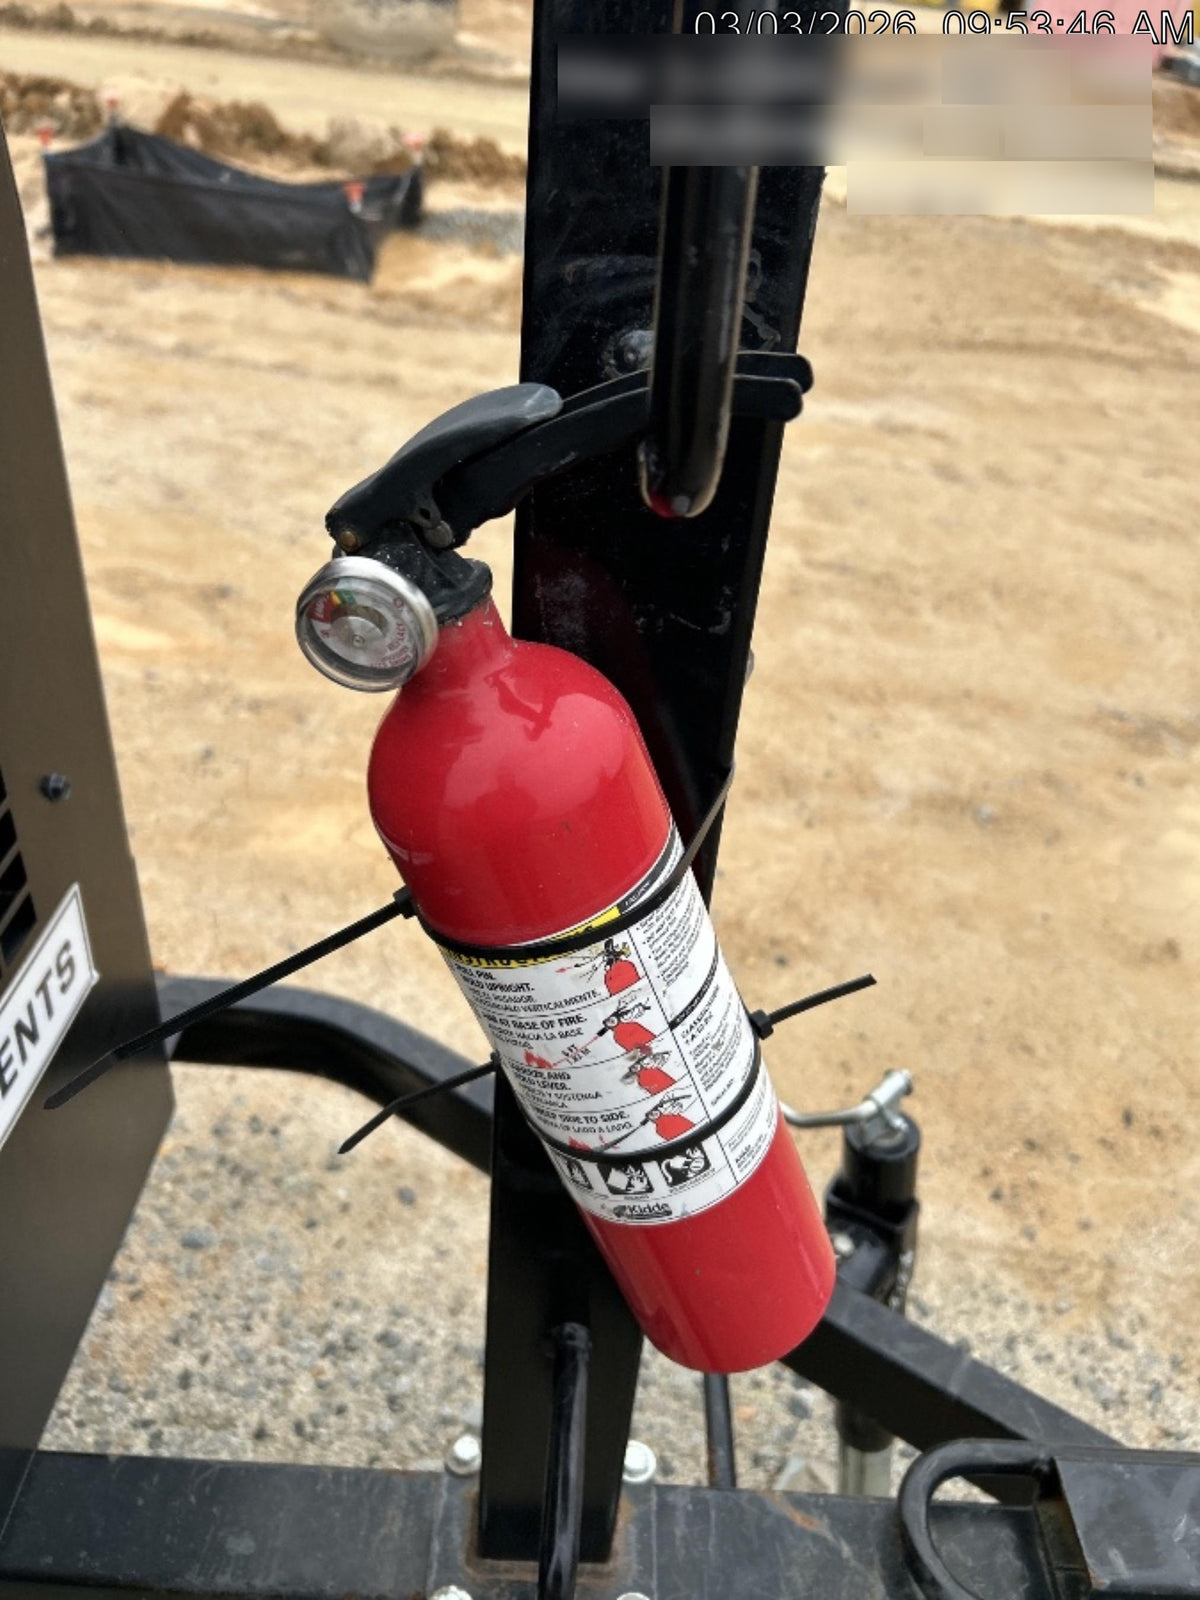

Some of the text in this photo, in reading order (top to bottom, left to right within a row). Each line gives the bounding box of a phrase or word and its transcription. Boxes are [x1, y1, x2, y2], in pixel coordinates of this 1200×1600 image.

[484, 982, 535, 993] UPRIGHT.
[511, 1020, 540, 1030] BASE
[540, 1019, 555, 1030] OF
[558, 1012, 588, 1027] FIRE.
[583, 1115, 598, 1124] TO
[600, 1110, 630, 1122] SIDE.
[628, 1203, 670, 1217] Kidde
